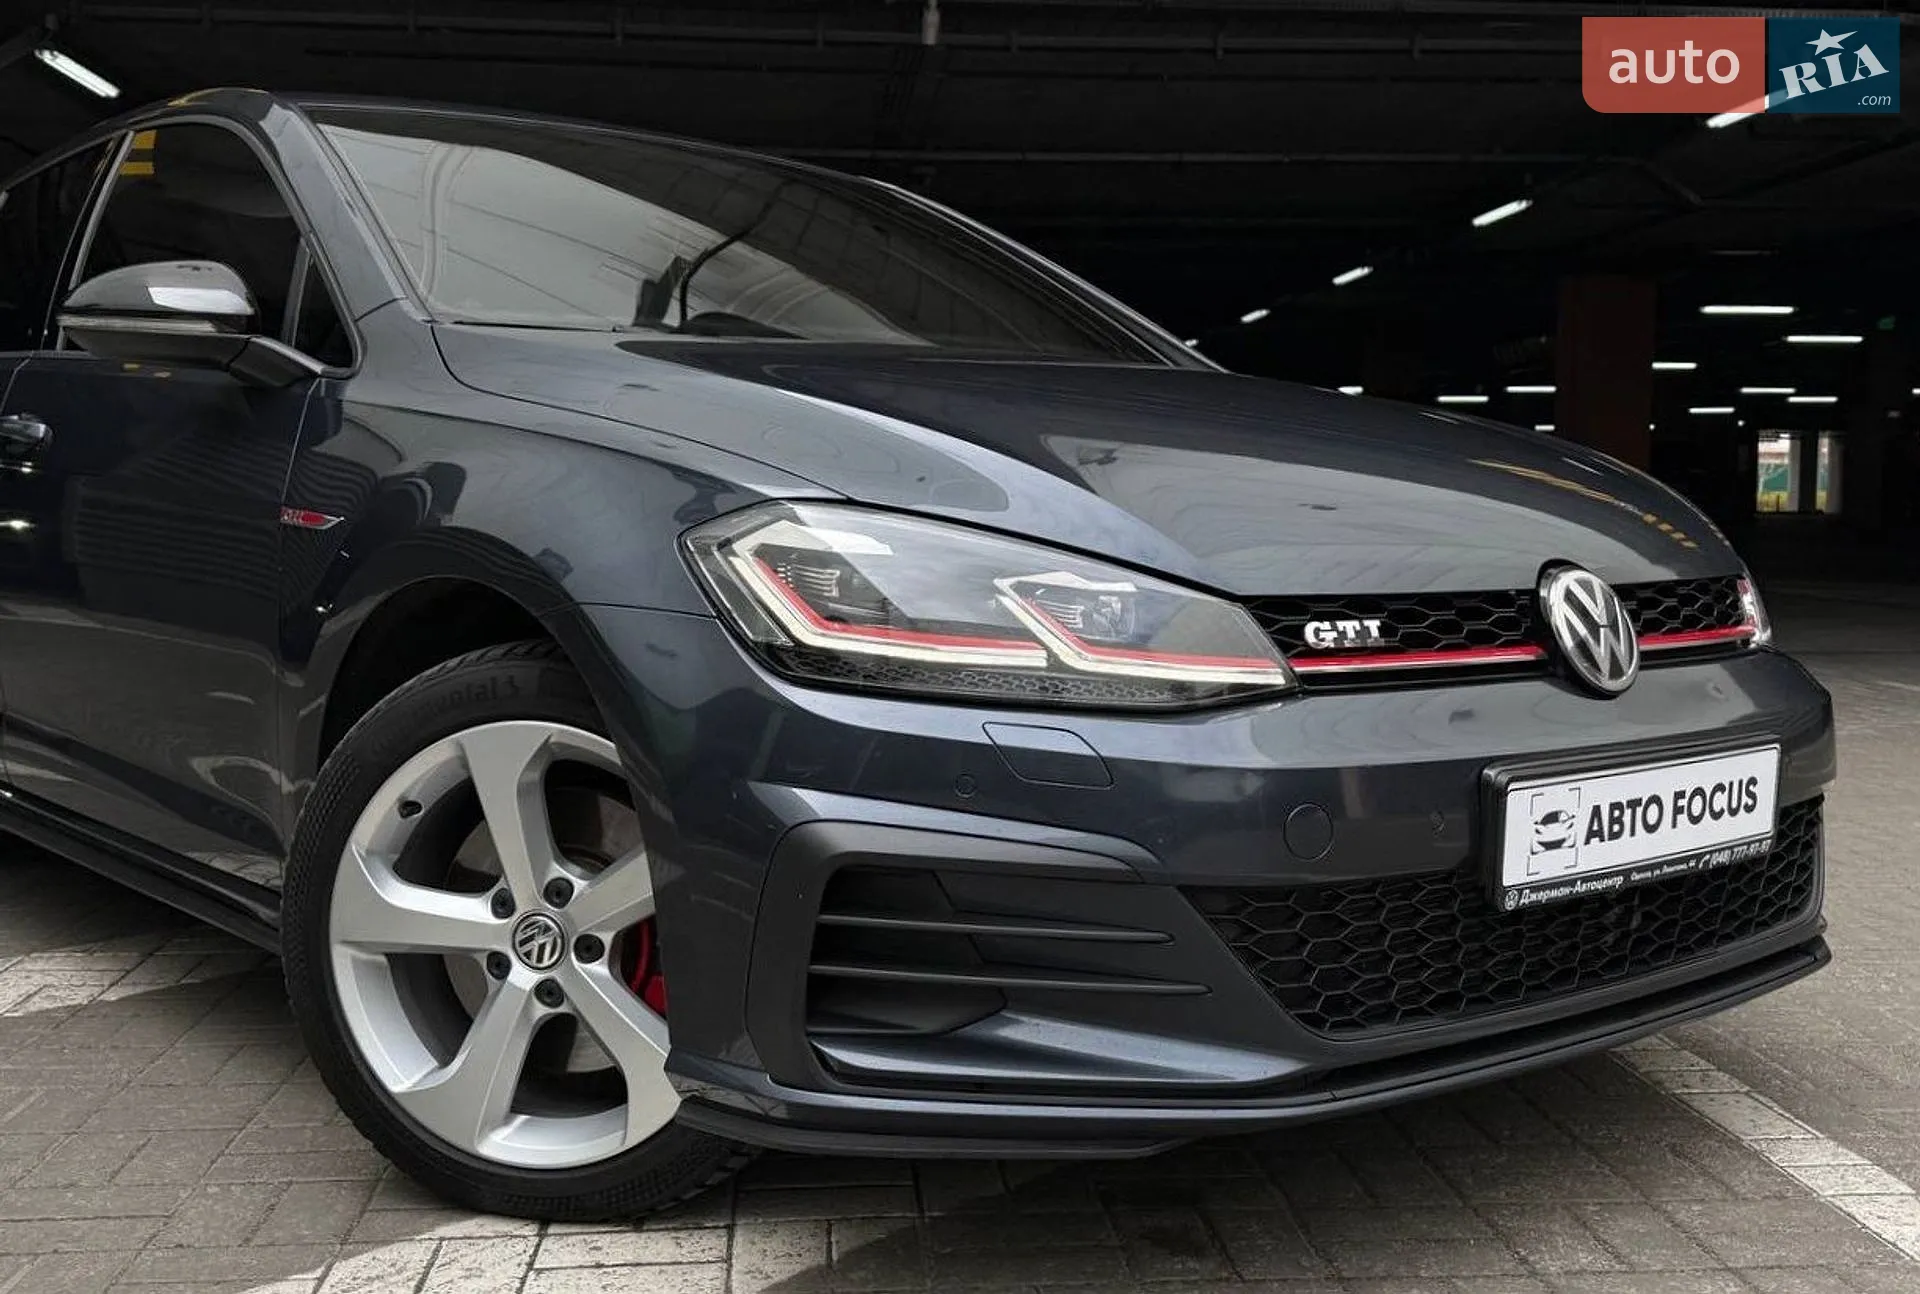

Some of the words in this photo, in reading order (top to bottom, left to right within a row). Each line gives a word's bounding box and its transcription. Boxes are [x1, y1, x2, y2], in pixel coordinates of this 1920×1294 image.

[1304, 620, 1384, 650] GTI
[1584, 794, 1664, 845] АВТО
[1670, 776, 1759, 829] FOCUS
[1519, 876, 1624, 905] Джерман-Автоцентр
